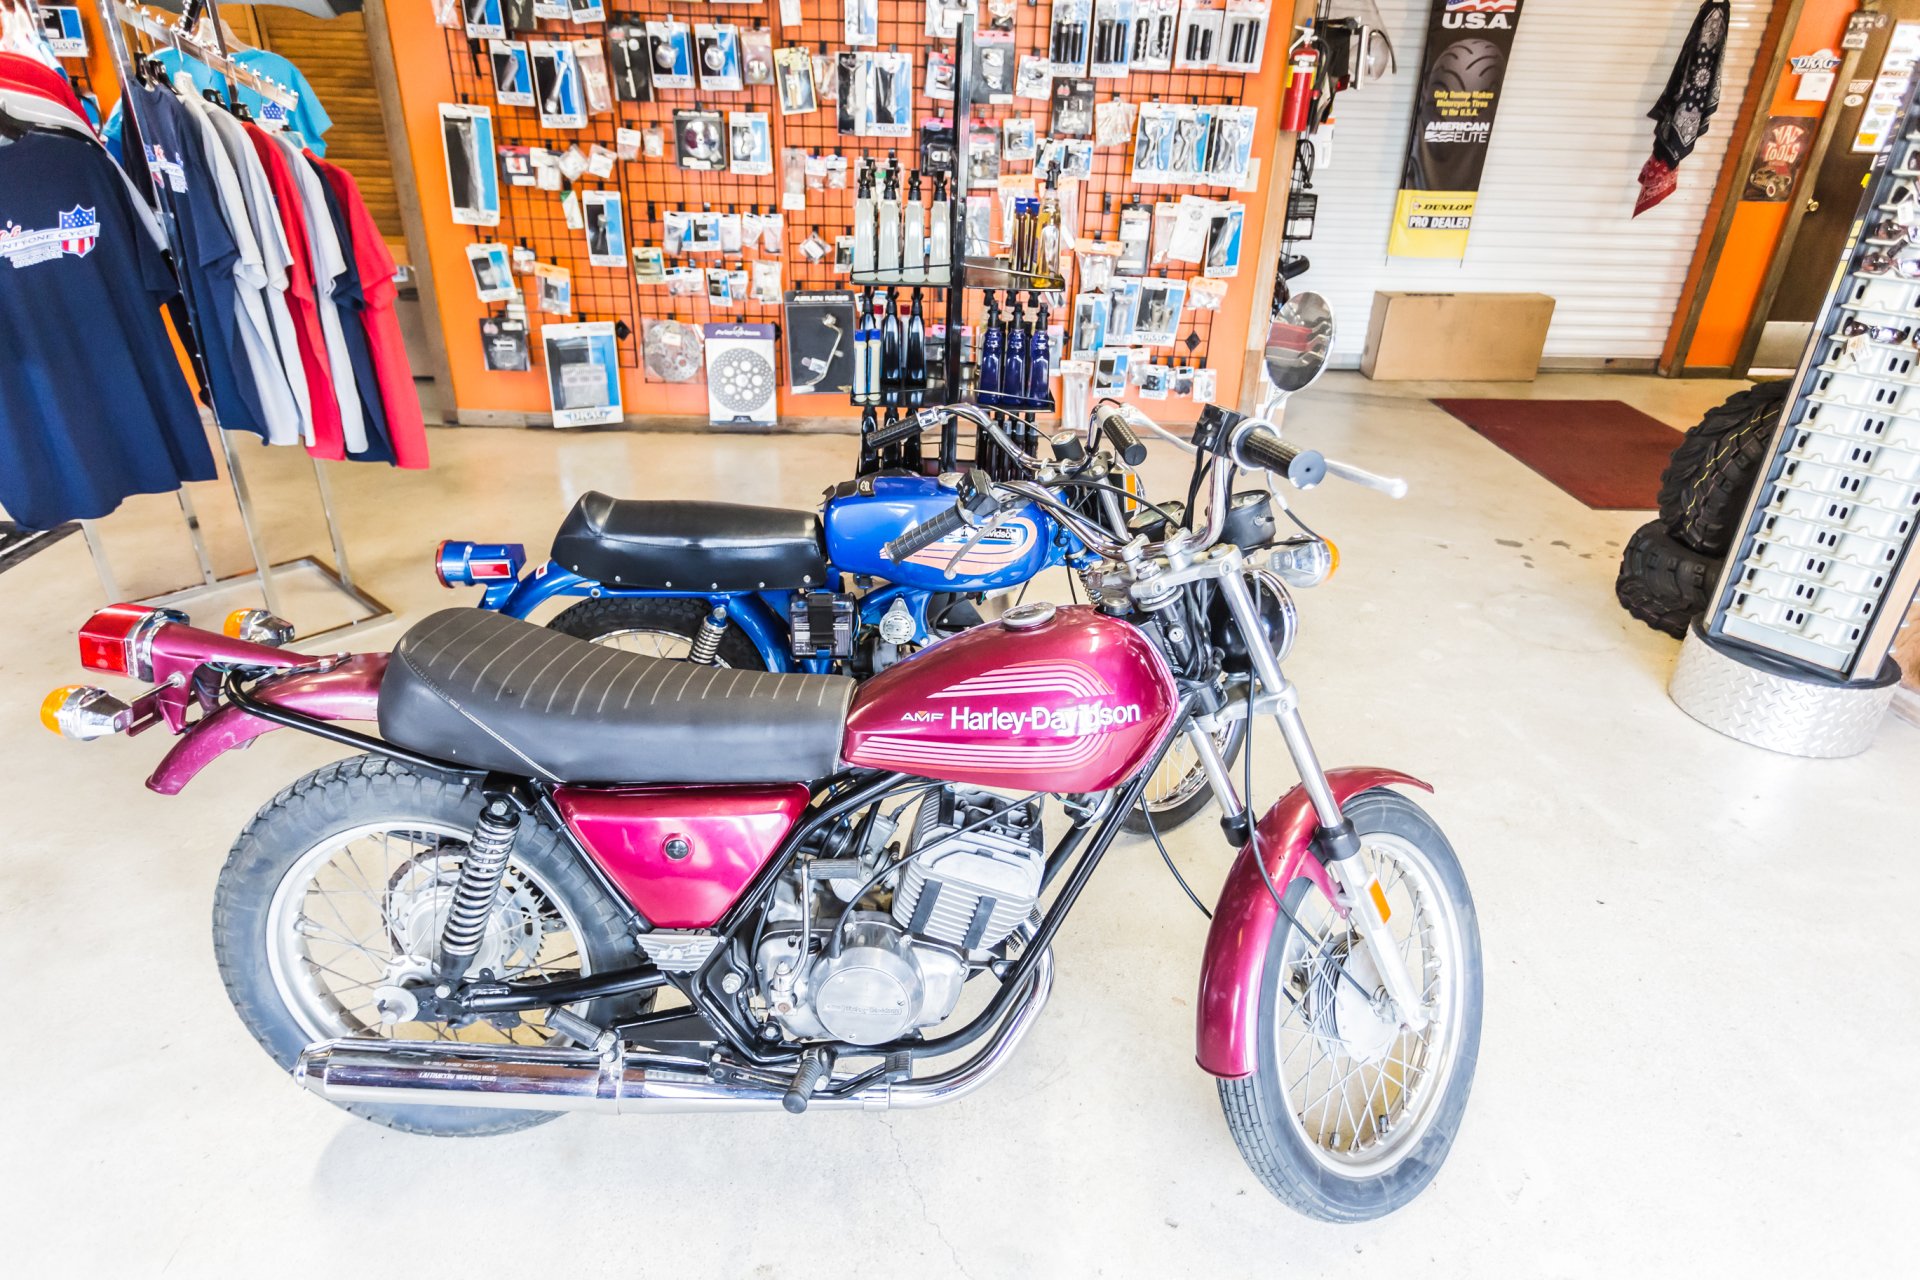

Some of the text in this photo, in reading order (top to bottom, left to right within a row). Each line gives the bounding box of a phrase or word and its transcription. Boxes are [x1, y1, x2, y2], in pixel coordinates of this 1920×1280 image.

[1442, 12, 1512, 29] U.S.A.
[1425, 121, 1490, 131] AMERICAN
[1453, 131, 1489, 142] ELITE
[1773, 125, 1804, 145] MAC
[1763, 142, 1800, 164] TOOLS
[1410, 216, 1470, 229] PRO DEALER
[901, 701, 1141, 734] AMF Harley-Davidson
